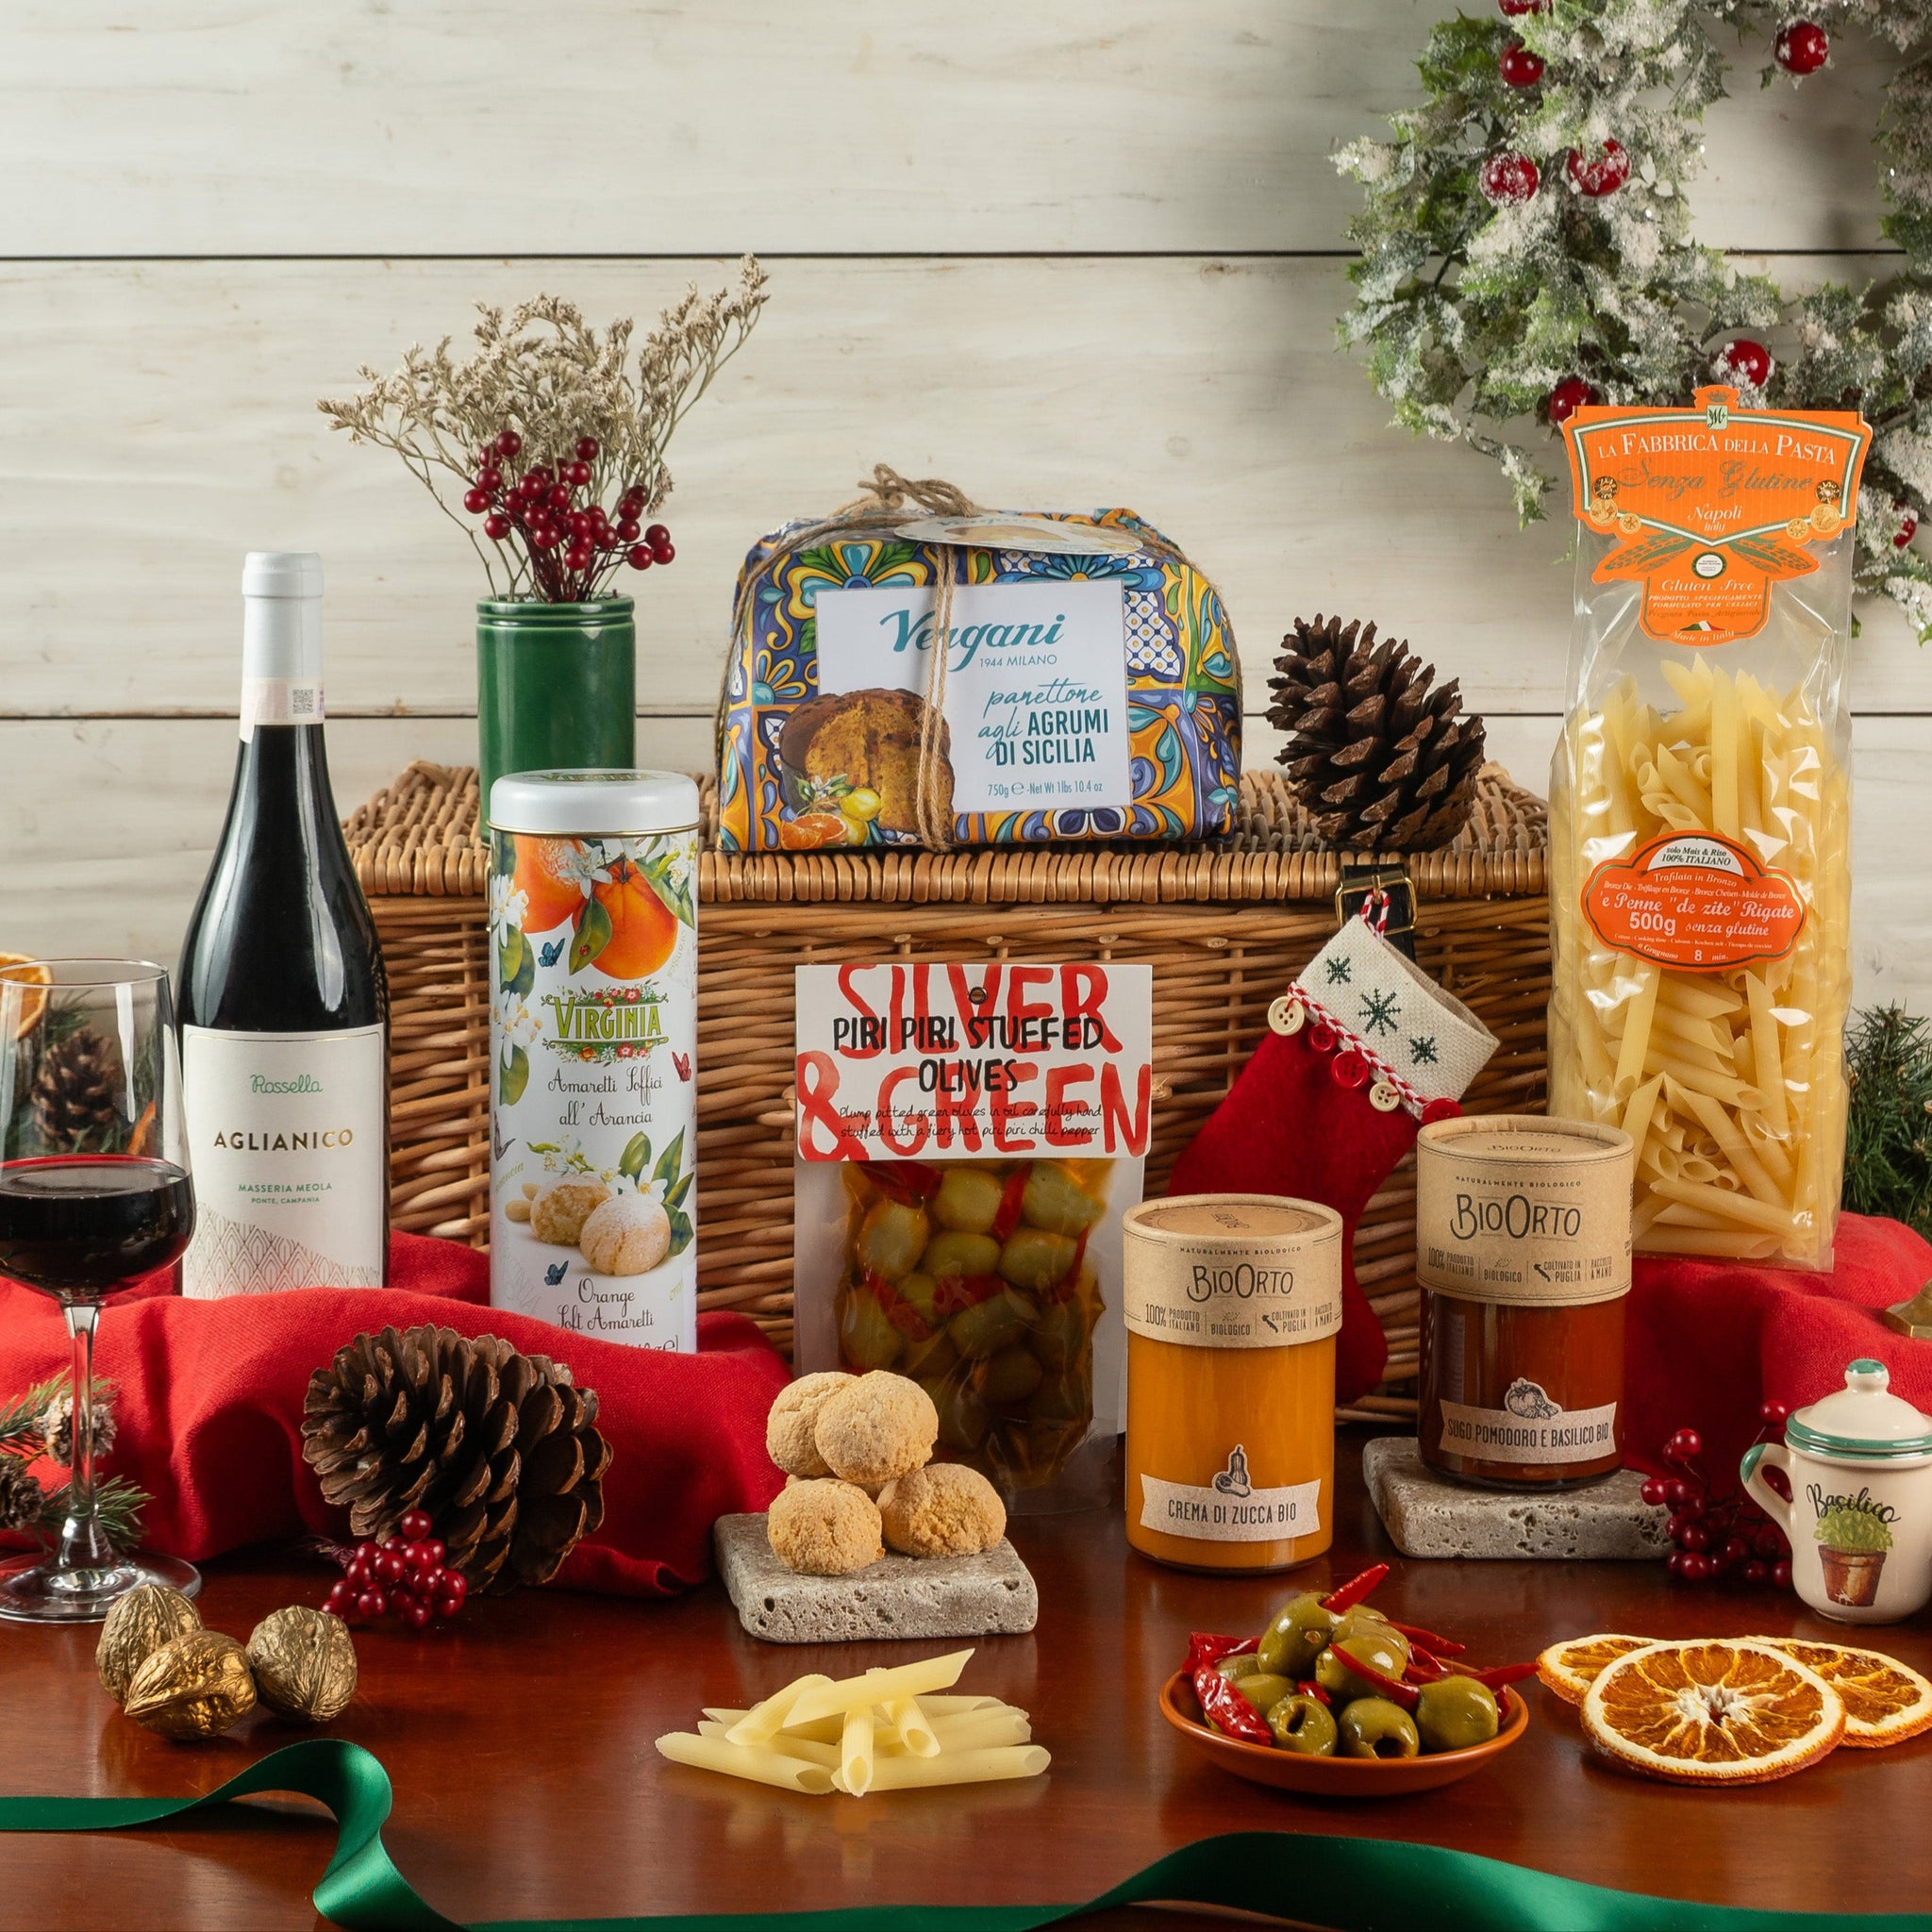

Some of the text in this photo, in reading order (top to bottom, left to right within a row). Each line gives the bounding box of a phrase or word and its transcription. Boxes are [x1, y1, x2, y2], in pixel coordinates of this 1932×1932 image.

[1618, 458, 1813, 501] Senza Glutine
[1688, 504, 1742, 523] Napoli
[1704, 522, 1725, 532] Italy
[1661, 578, 1754, 591] Gluten Free
[879, 609, 1065, 672] Vergani
[1674, 629, 1697, 641] Made
[1712, 629, 1735, 641] Italy
[980, 654, 1058, 668] 1944 MILANO
[983, 677, 1103, 719] panettone
[978, 706, 1108, 759] agli AGRUMI
[996, 738, 1095, 766] DI SICILIA
[988, 783, 1008, 798] 750g
[1074, 780, 1091, 792] 10.4
[1094, 783, 1103, 792] oz
[1661, 854, 1731, 866] 100% ITALIANO
[1654, 872, 1691, 883] Trafilata
[1707, 874, 1737, 887] Bronzo
[1614, 892, 1663, 911] Penne
[1740, 900, 1794, 923] Rigate
[1629, 911, 1769, 939] 500g senza glutine
[1694, 949, 1702, 961] 8
[554, 996, 661, 1040] VIRGINIA
[838, 964, 1123, 1059] SILVER
[833, 1016, 1104, 1050] PIRI PIRI STUFFED
[249, 1074, 323, 1094] Rossella
[548, 1065, 663, 1106] Amaretti Soffici
[919, 1058, 1018, 1092] OLIVES
[590, 1102, 653, 1126] Arancia
[796, 1050, 1151, 1161] & GREEN
[840, 1103, 1102, 1122] Plump pitted green olives in oil carefully hand
[214, 1128, 354, 1151] AGLIANICO
[841, 1121, 1100, 1141] stuffed with a fiery hot piri piri chilli pepper
[238, 1182, 332, 1193] MASSERIA MEOLA
[1456, 1175, 1524, 1187] NATURALMENTE
[251, 1197, 278, 1206] PONTE,
[1180, 1246, 1301, 1256] NATURALMENTE BIOLOGICO
[1428, 1246, 1445, 1270] 100%
[1484, 1269, 1522, 1283] BIOLOGICO
[1543, 1260, 1574, 1271] COLTIVATO
[1555, 1271, 1581, 1283] PUGLIA
[578, 1277, 635, 1318] Orange
[587, 1306, 655, 1330] Amaretti
[1145, 1303, 1201, 1327] 100% PRODOTTO
[1283, 1318, 1307, 1333] PUGLIA
[1169, 1320, 1201, 1333] ITALIANO
[1211, 1323, 1251, 1336] BIOLOGICO
[1448, 1418, 1609, 1448] SUGO POMODORO E BASILICO BIO
[1168, 1499, 1296, 1524] CREMA DI ZUCCA BIO
[1806, 1483, 1902, 1524] Basilico
